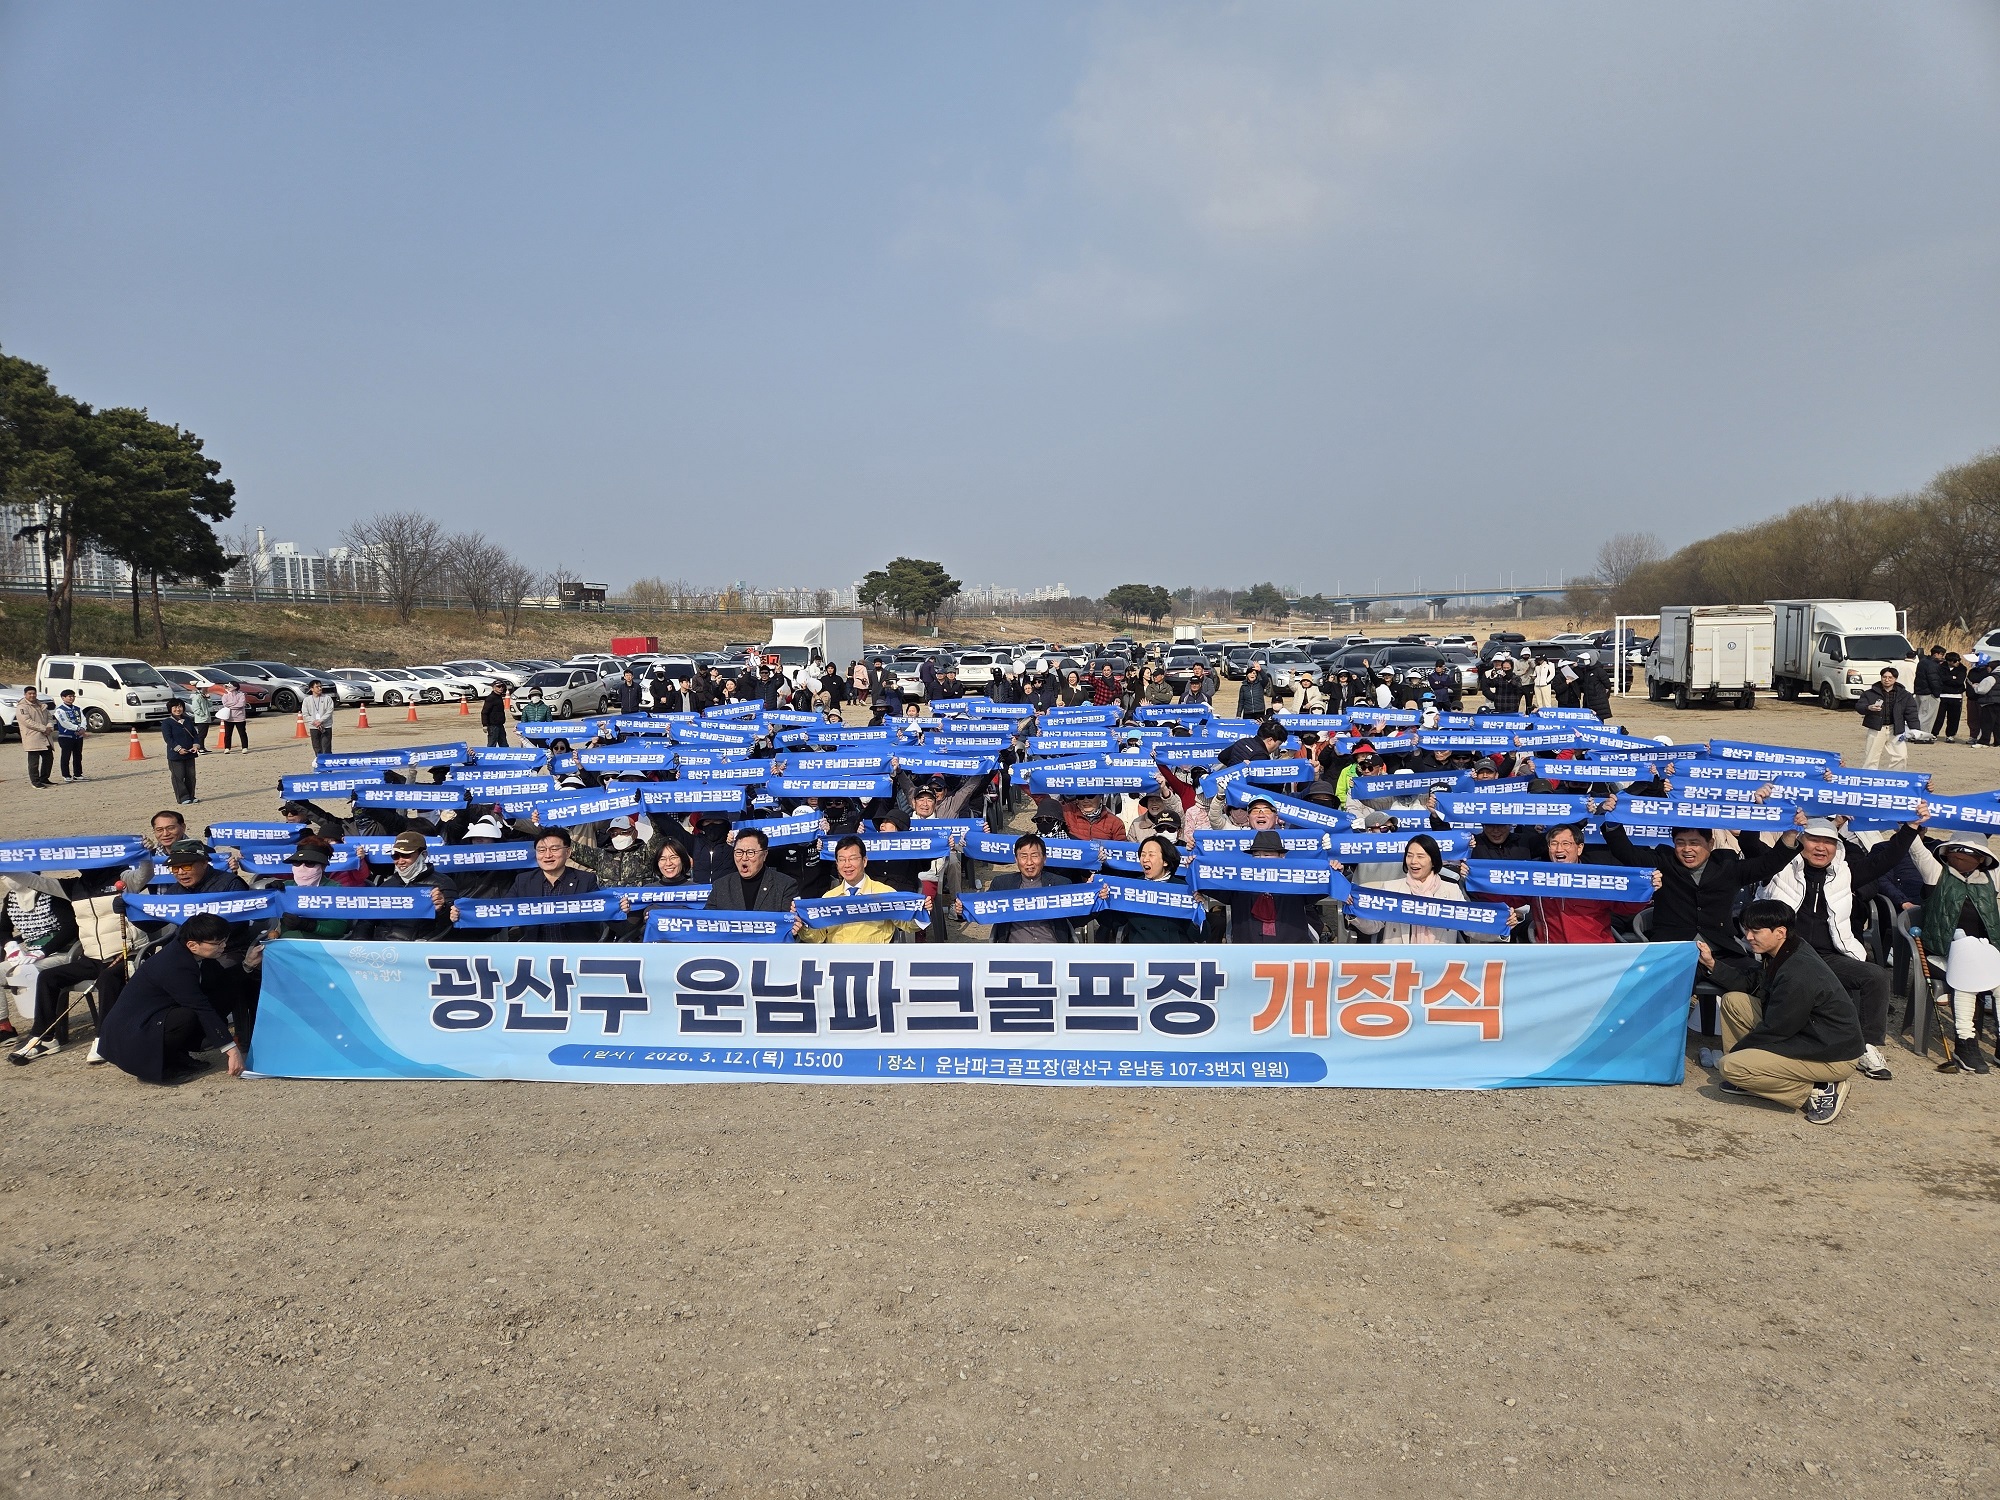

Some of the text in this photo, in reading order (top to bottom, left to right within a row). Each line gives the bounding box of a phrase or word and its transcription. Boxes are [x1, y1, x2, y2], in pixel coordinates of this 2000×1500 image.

[1066, 715, 1105, 724] 운남파크골프장
[680, 730, 698, 738] 광산구
[700, 732, 744, 743] 운남파크골프장
[782, 734, 798, 742] 광산구
[840, 732, 886, 740] 운남파크골프장
[1217, 730, 1237, 738] 광산구
[1423, 736, 1508, 744] 광산구 운남파크골프장
[1038, 740, 1107, 749] 광산구 운남파크골프장
[581, 755, 664, 763] 광산구 운남파크골프장
[1168, 751, 1189, 759] 광산구
[1723, 748, 1826, 764] 광산구 운남파크골프장
[799, 758, 881, 769] 광산구 운남파크골프장
[899, 757, 979, 769] 광산구 운남파크골프장
[457, 772, 481, 780] 광산구
[688, 768, 764, 779] 광산구 운남파크골프장
[1545, 765, 1637, 776] 광산구 운남파크골프장
[1690, 768, 1722, 778] 광산구
[293, 782, 318, 792] 광산구
[783, 781, 875, 789] 광산구 운남파크골프장
[1047, 778, 1142, 787] 광산구 운남파크골프장
[1367, 782, 1393, 791] 광산구
[486, 783, 548, 796] 운남파크골프장
[1684, 786, 1722, 799] 광산구
[366, 791, 458, 801] 광산구 운남파크골프장
[644, 793, 671, 803] 광산구
[674, 790, 742, 802] 운남파크골프장
[505, 802, 533, 812] 광산구
[548, 806, 577, 819] 광산구
[1453, 803, 1571, 815] 광산구 운남파크골프장
[1631, 800, 1782, 820] 광산구 운남파크골프장
[1929, 803, 1956, 818] 산구
[981, 841, 1009, 853] 광산구
[1203, 840, 1236, 851] 광산구
[1340, 842, 1372, 854] 광산구
[40, 845, 125, 860] 운남파크골프장
[453, 850, 528, 864] 운남파크골프장
[253, 854, 281, 864] 광산구
[1200, 865, 1330, 883] 광산구 운남파크골프장
[1490, 870, 1629, 890] 광산구 운남파크골프장
[298, 896, 414, 908] 광산구 운남파크골프장
[974, 900, 1009, 914] 광산구
[1013, 892, 1095, 911] 운남파크골프장
[476, 900, 605, 917] 광산구 운남파크골프장
[807, 906, 842, 919] 광산구
[1359, 895, 1497, 923] 광산구 운남파크골프장
[658, 919, 776, 933] 광산구 운남파크골프장
[427, 955, 1507, 1042] 광산구 운남파크골프장 개장식
[700, 1051, 716, 1063] 3.
[793, 1051, 844, 1069] 15:00
[935, 1055, 1114, 1078] 운남파크골프장(광산구
[1118, 1061, 1165, 1078] 운남동
[1169, 1061, 1247, 1078] 107-3번지
[1251, 1062, 1289, 1080] 일원)
